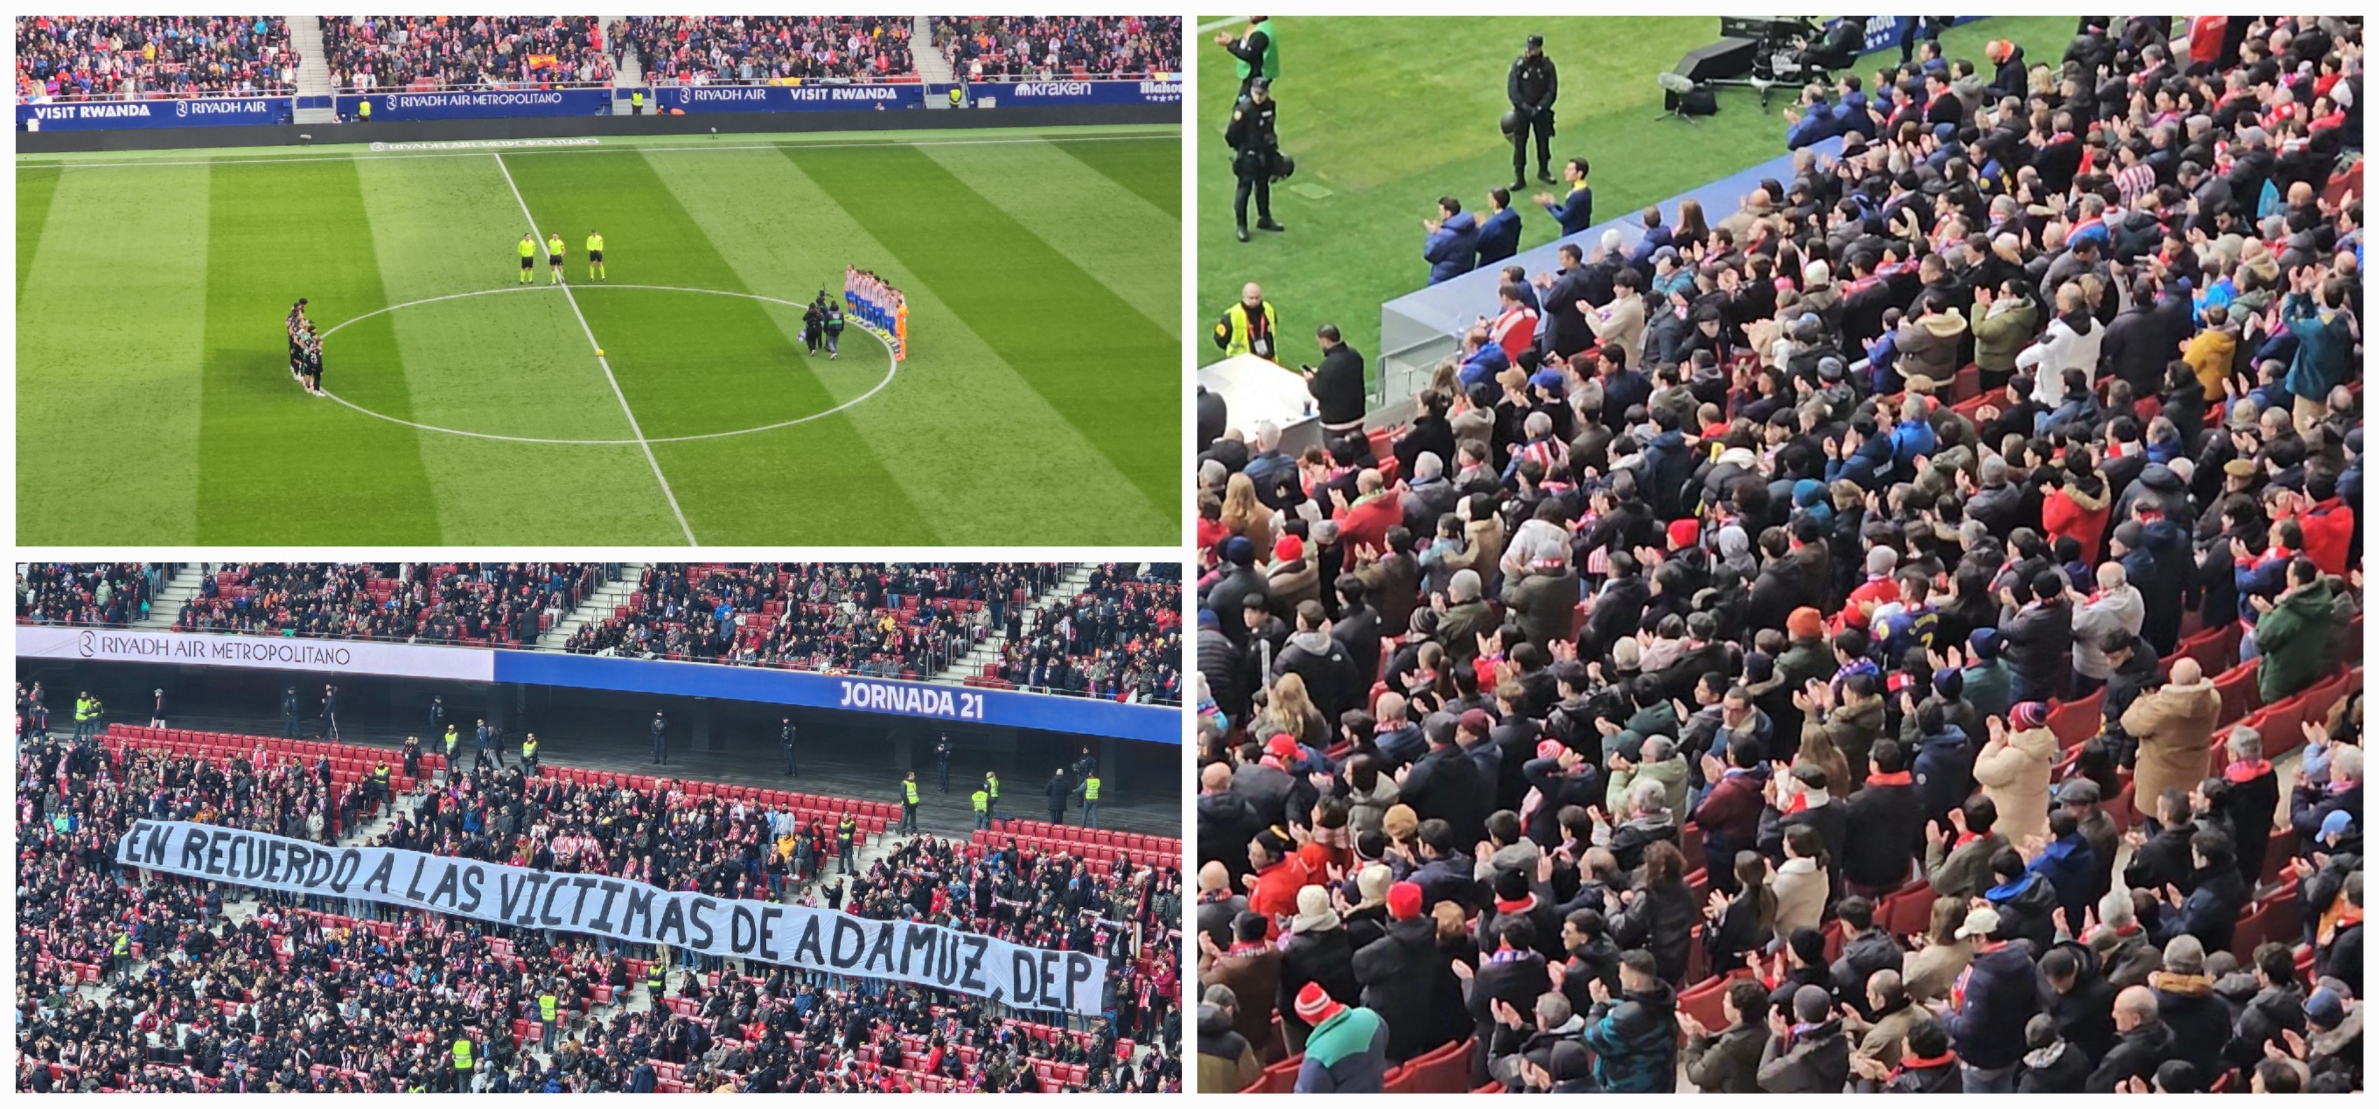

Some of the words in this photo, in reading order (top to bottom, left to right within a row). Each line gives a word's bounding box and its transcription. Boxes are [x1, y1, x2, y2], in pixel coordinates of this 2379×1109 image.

[694, 89, 741, 101] RIYADH
[744, 89, 766, 100] AIR
[790, 88, 828, 100] VISIT
[832, 87, 897, 100] RWANDA
[1031, 82, 1092, 96] kraken
[401, 95, 447, 107] RIYADH
[449, 95, 471, 106] AIR
[472, 92, 562, 105] METROPOLITANO
[35, 106, 76, 119] VISIT
[80, 104, 151, 118] RWANDA
[192, 101, 241, 114] RIYADH
[243, 101, 267, 112] AIR
[388, 141, 446, 150] RIYADH
[451, 140, 478, 148] AIR
[481, 137, 600, 148] METROPOLITANO
[101, 636, 169, 656] RIYADH
[174, 640, 206, 658] AIR
[211, 642, 350, 665] METROPOLITANO
[841, 681, 955, 716] JORNADA
[960, 693, 983, 719] 21
[125, 822, 174, 866] EN
[180, 828, 362, 894] RECUERDO
[363, 852, 395, 894] A
[405, 856, 484, 913] LAS
[730, 905, 783, 960] DE
